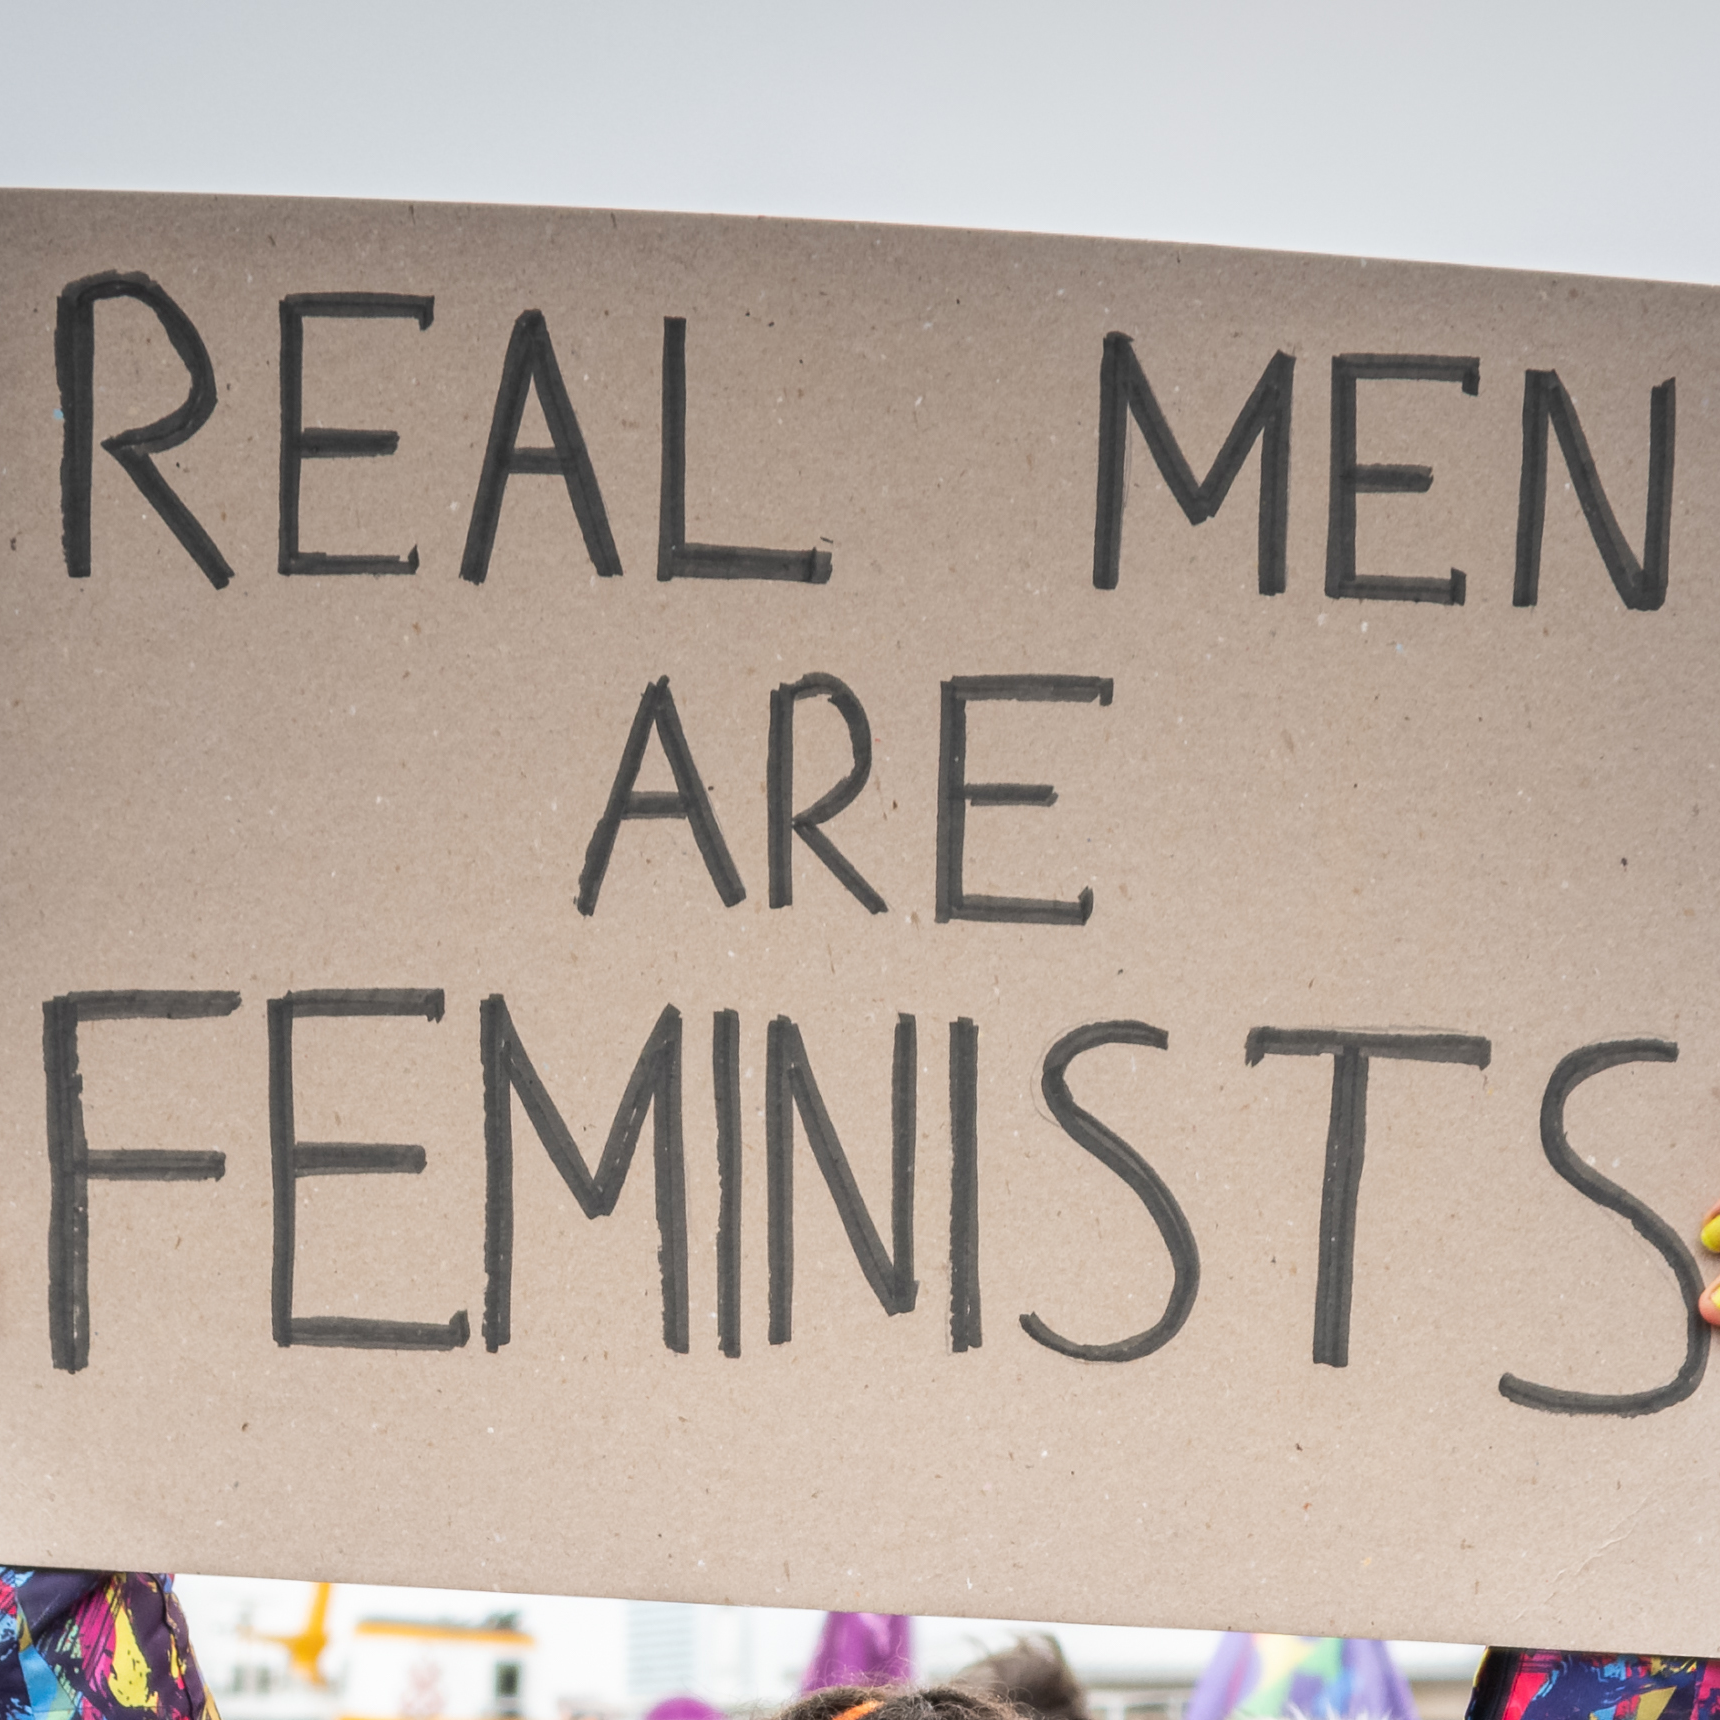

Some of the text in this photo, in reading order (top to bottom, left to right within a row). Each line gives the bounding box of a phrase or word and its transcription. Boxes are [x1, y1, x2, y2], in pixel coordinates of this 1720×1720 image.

[52, 268, 1678, 613] REAL MEN
[576, 672, 1115, 927] ARE
[41, 988, 1713, 1417] FEMINISTS
